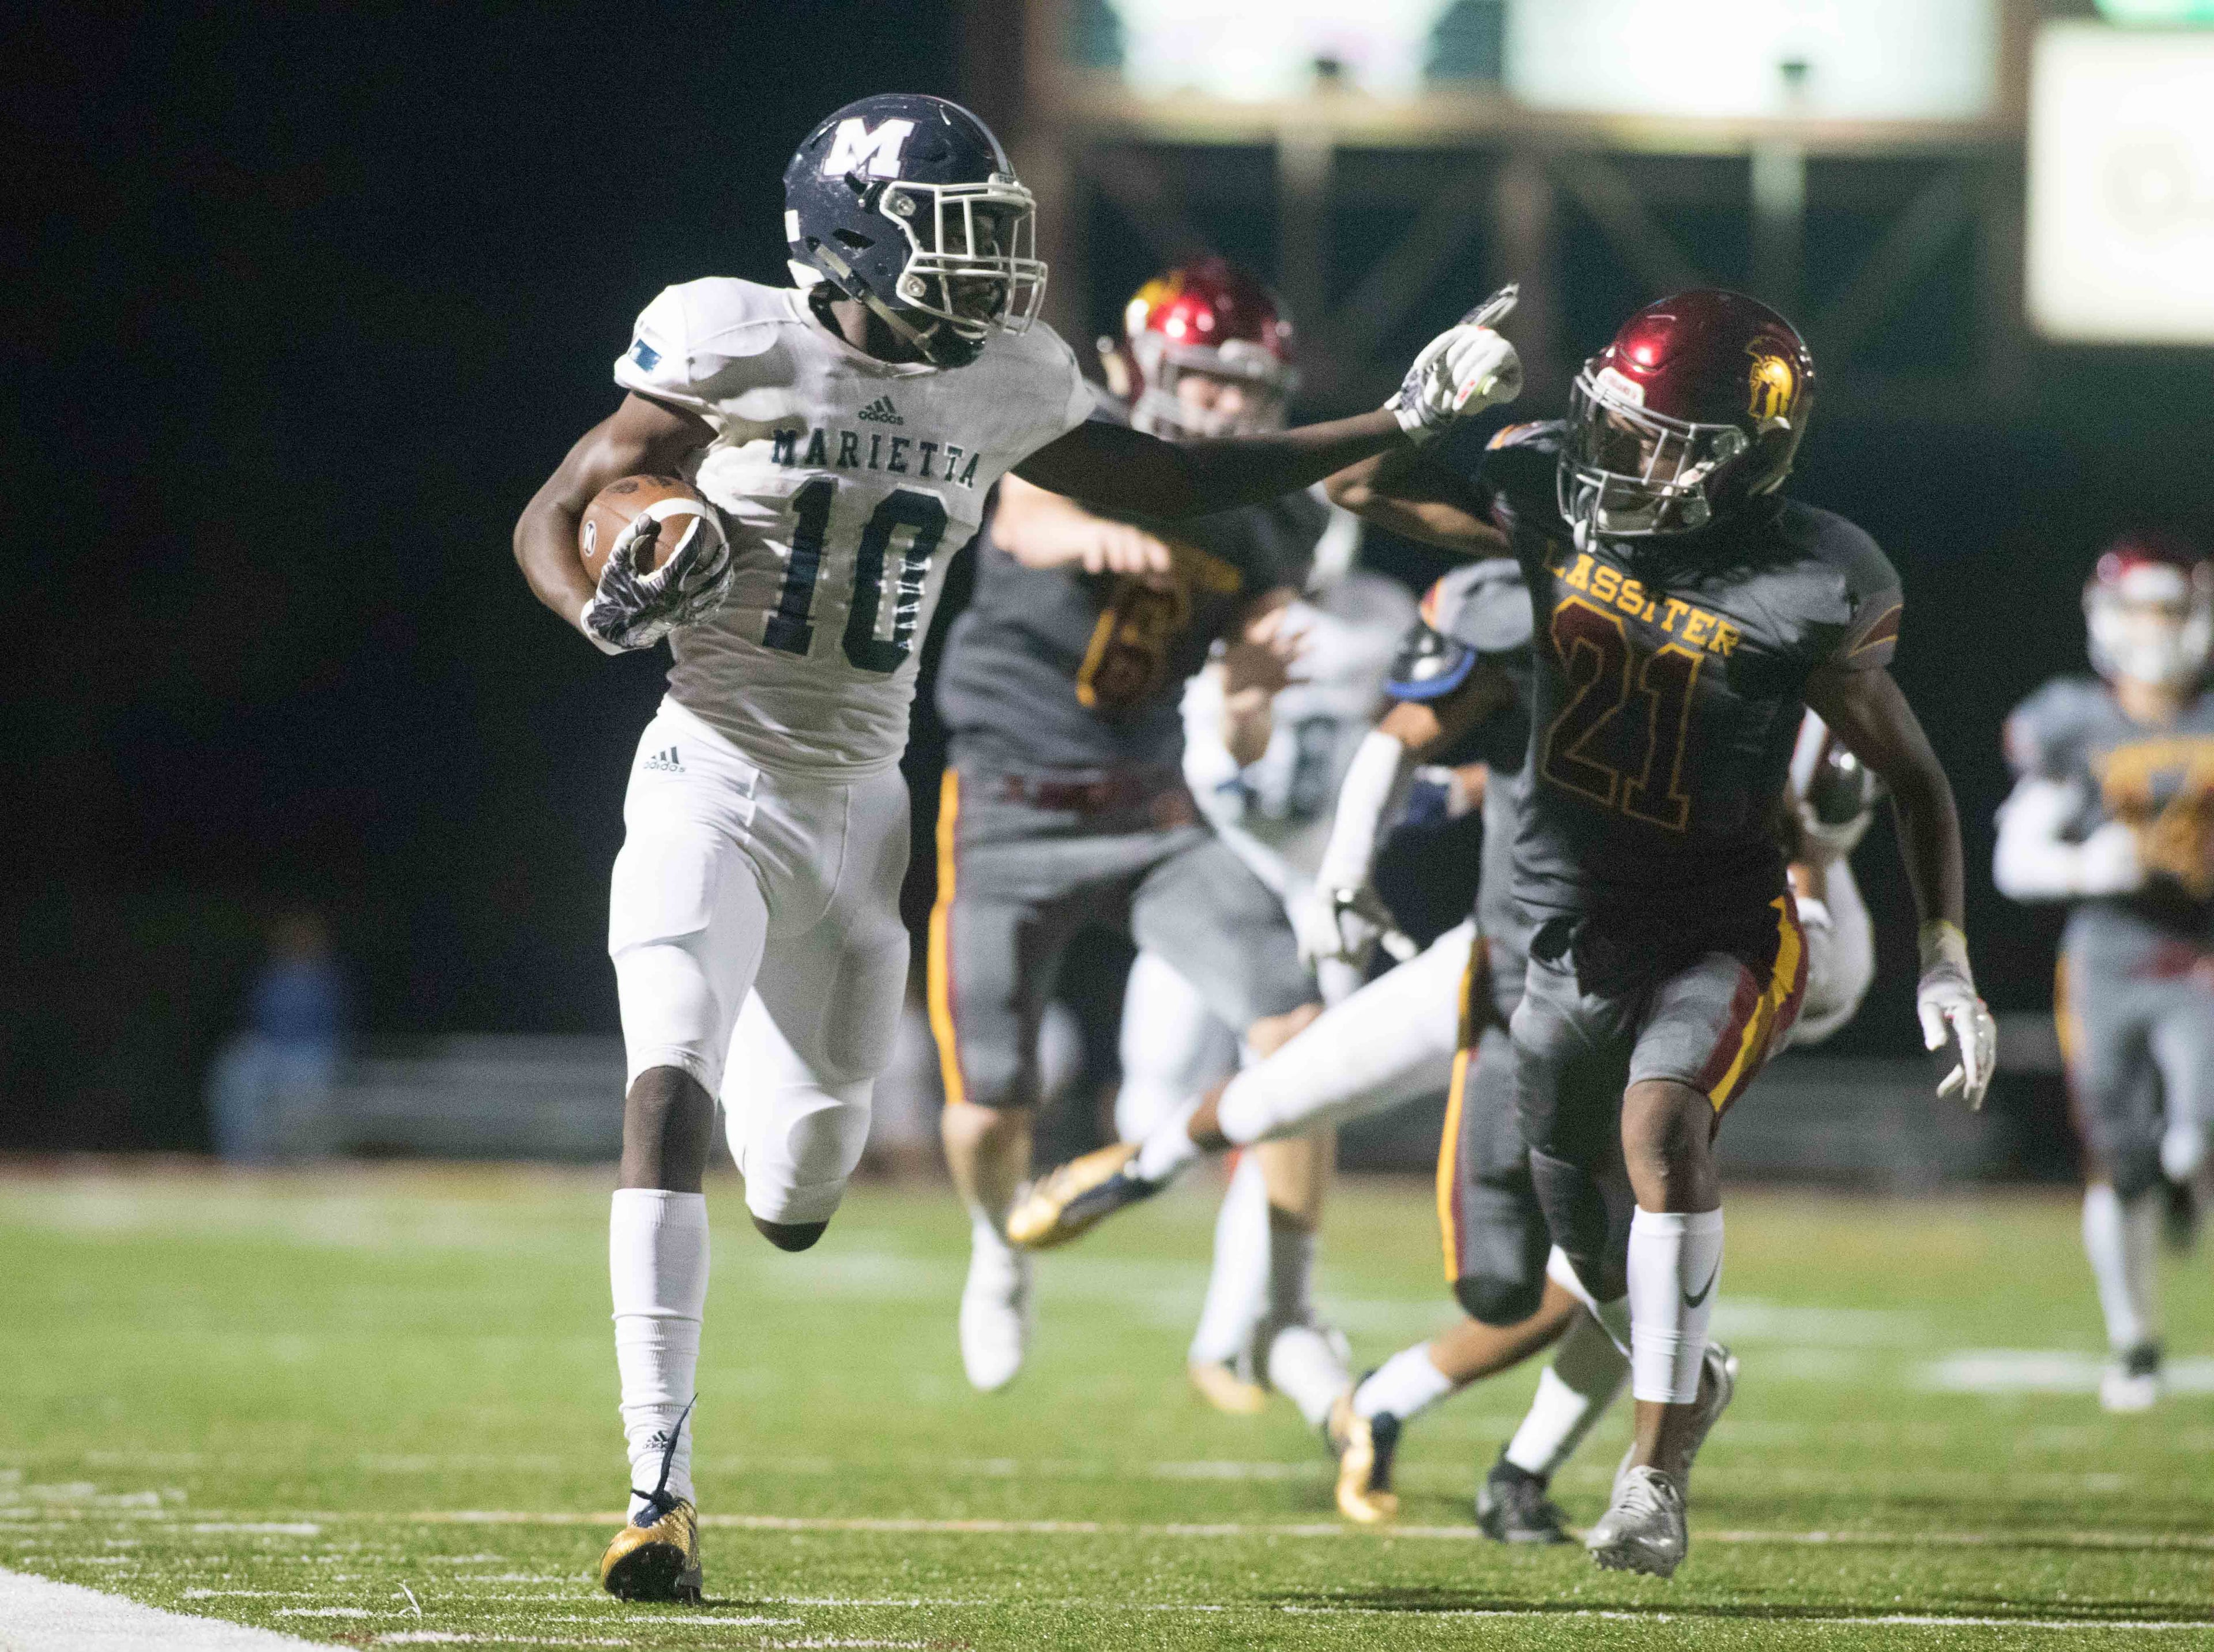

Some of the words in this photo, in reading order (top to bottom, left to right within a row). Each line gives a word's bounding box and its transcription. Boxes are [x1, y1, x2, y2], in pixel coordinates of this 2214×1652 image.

[820, 117, 916, 180] M
[858, 410, 904, 425] adidas
[771, 428, 980, 489] MARIETTA
[762, 476, 948, 673] 10
[1543, 538, 1740, 656] LASSITER
[1543, 595, 1705, 833] 21
[643, 761, 686, 772] adidas
